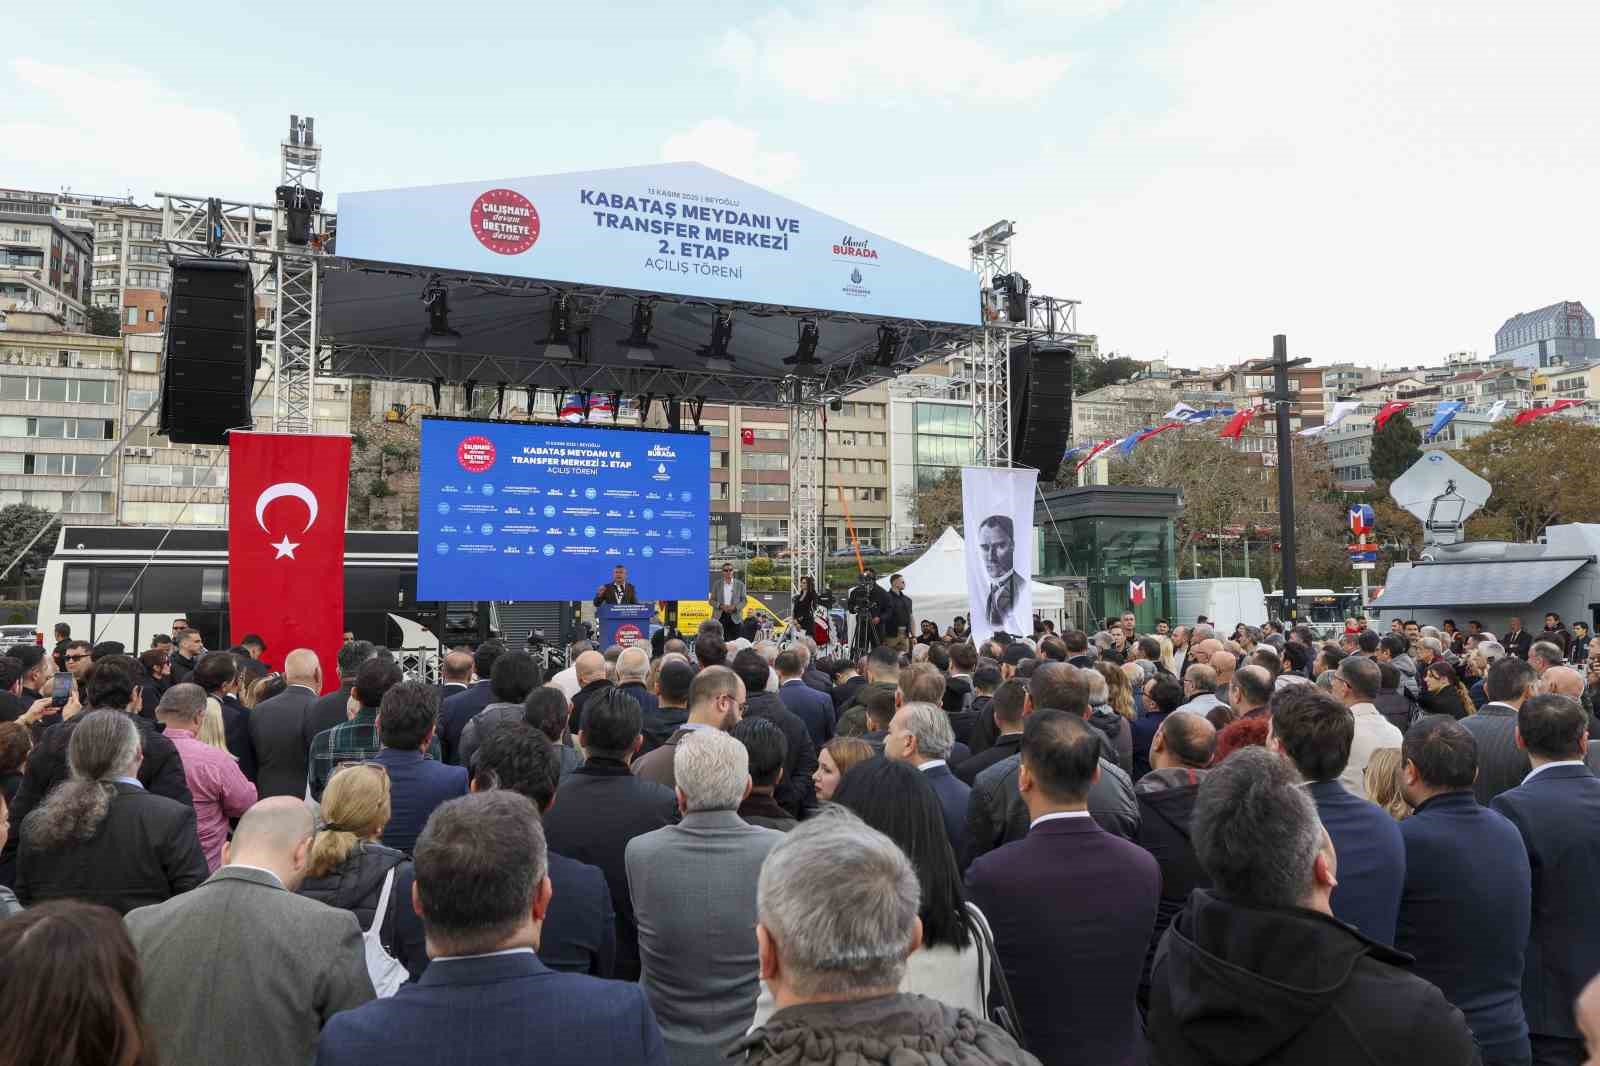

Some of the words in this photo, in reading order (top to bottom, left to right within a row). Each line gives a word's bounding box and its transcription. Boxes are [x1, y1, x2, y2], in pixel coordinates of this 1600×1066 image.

[657, 189, 681, 199] KASIM
[580, 189, 678, 219] KABATAŞ
[682, 204, 771, 229] MEYDANI
[775, 217, 800, 233] VE
[593, 211, 700, 240] TRANSFER
[705, 227, 788, 251] MERKEZİ
[658, 239, 676, 255] 2.
[680, 241, 730, 261] ETAP
[832, 244, 879, 260] BURADA
[644, 257, 690, 275] AÇILIŞ
[693, 263, 743, 281] TÖRENİ
[511, 456, 559, 465] TRANSFER
[560, 458, 600, 467] MERKEZİ
[610, 461, 632, 469] ETAP
[567, 449, 608, 459] MEYDANI
[609, 451, 622, 459] VE
[1350, 507, 1364, 529] M
[1129, 579, 1146, 600] M
